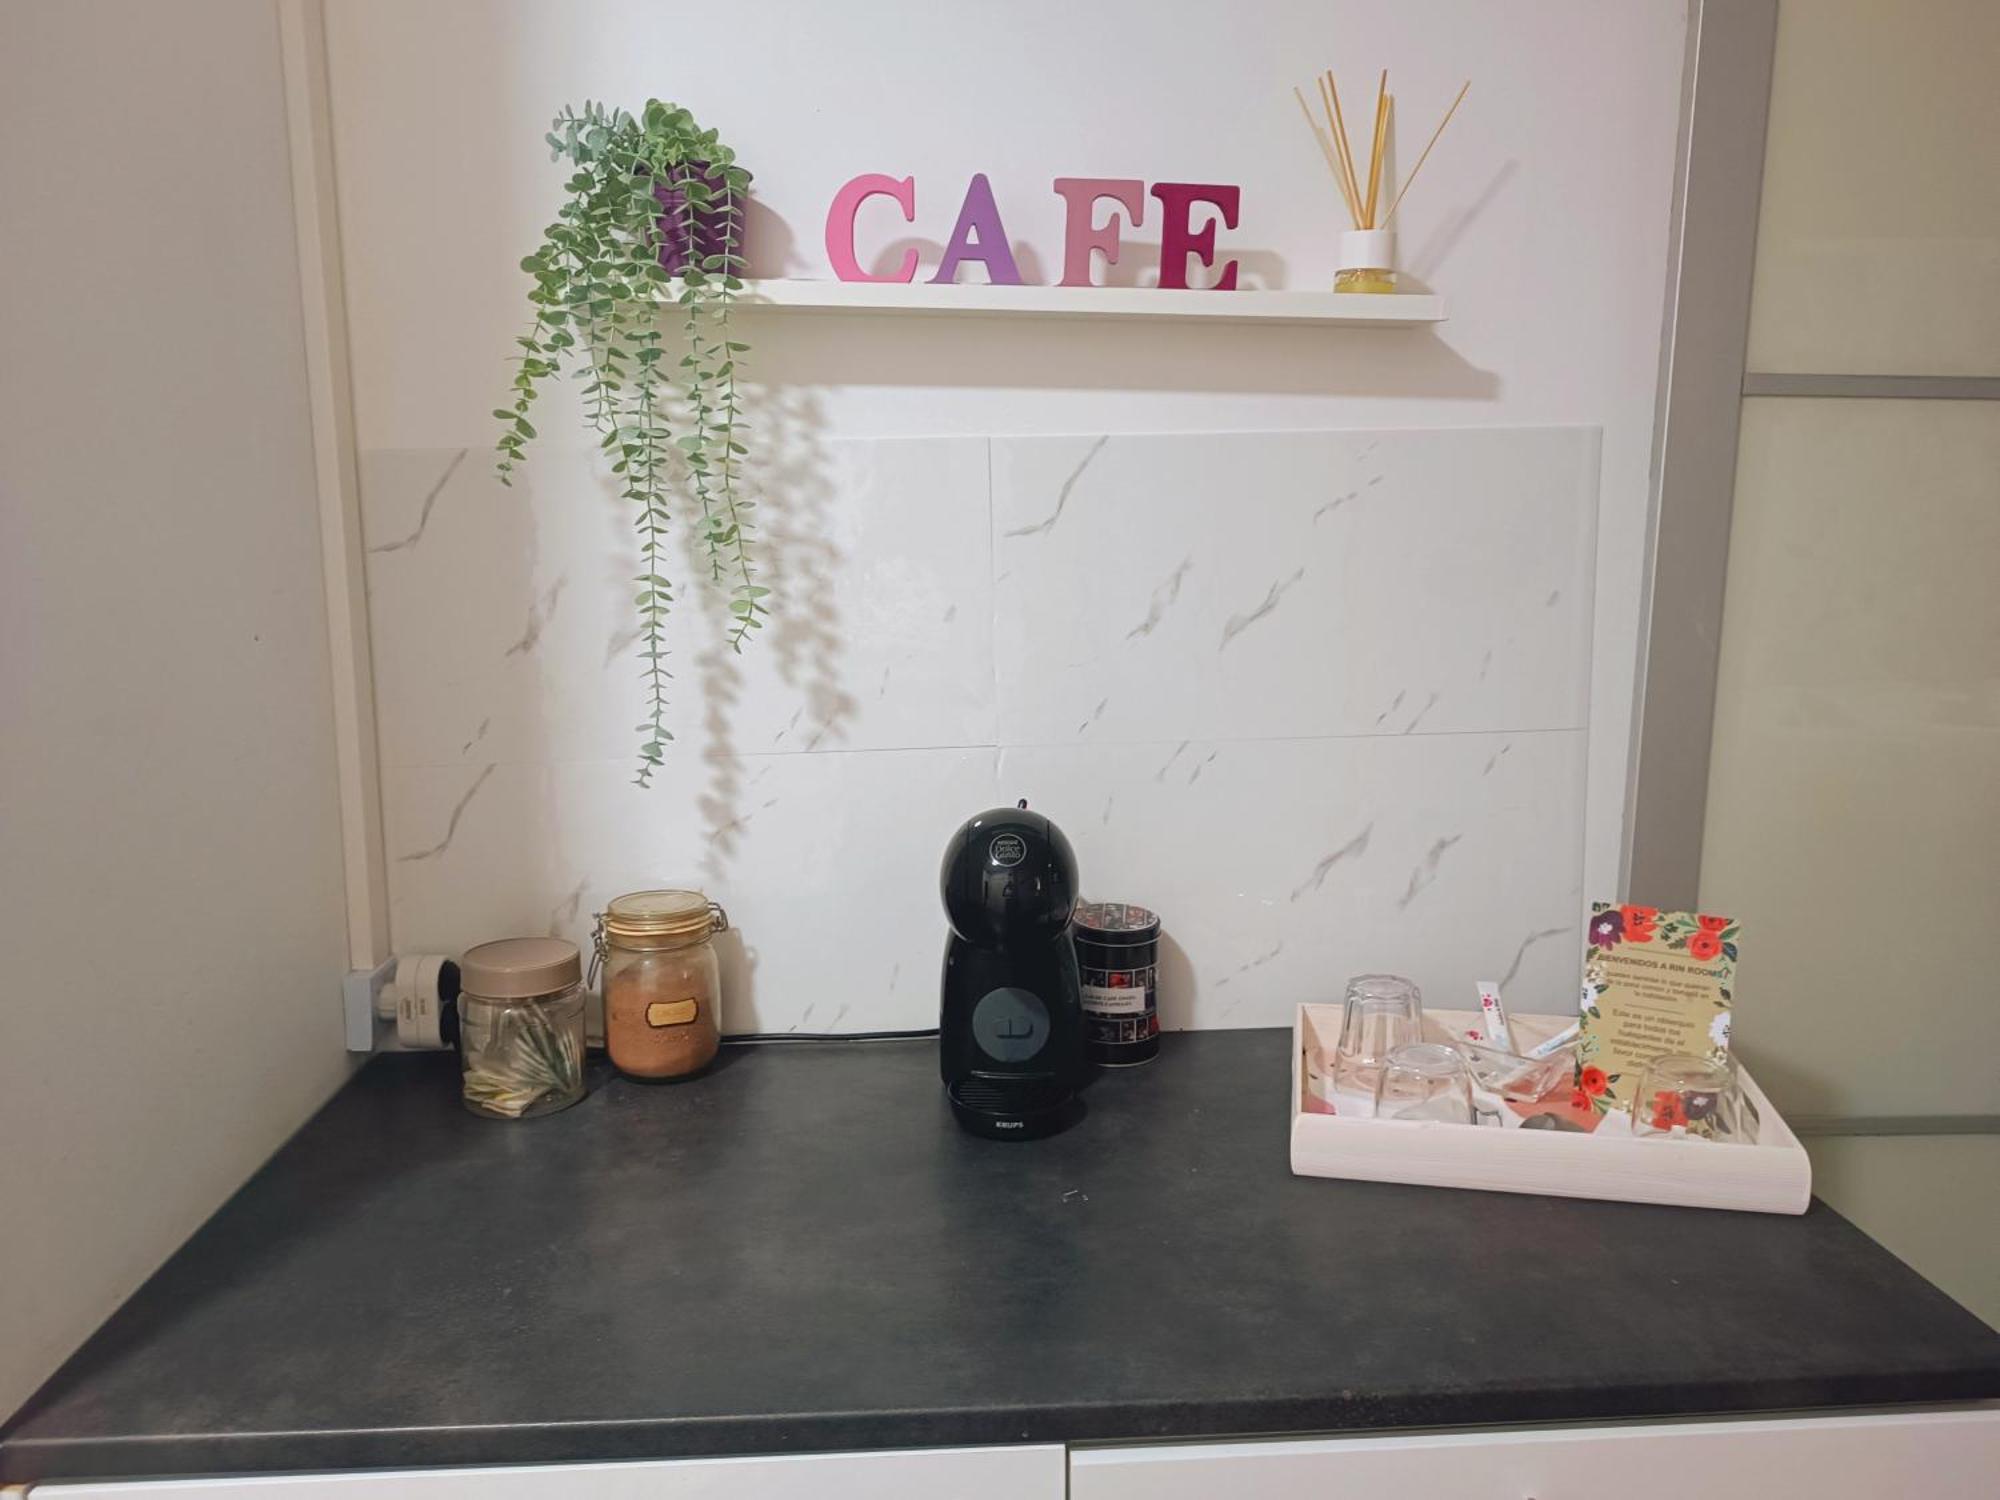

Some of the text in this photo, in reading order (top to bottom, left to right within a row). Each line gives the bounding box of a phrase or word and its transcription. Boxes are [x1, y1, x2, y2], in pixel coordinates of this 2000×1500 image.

[825, 173, 1241, 291] CAFE
[1660, 962, 1667, 970] A
[996, 1121, 1024, 1129] KRUPS
